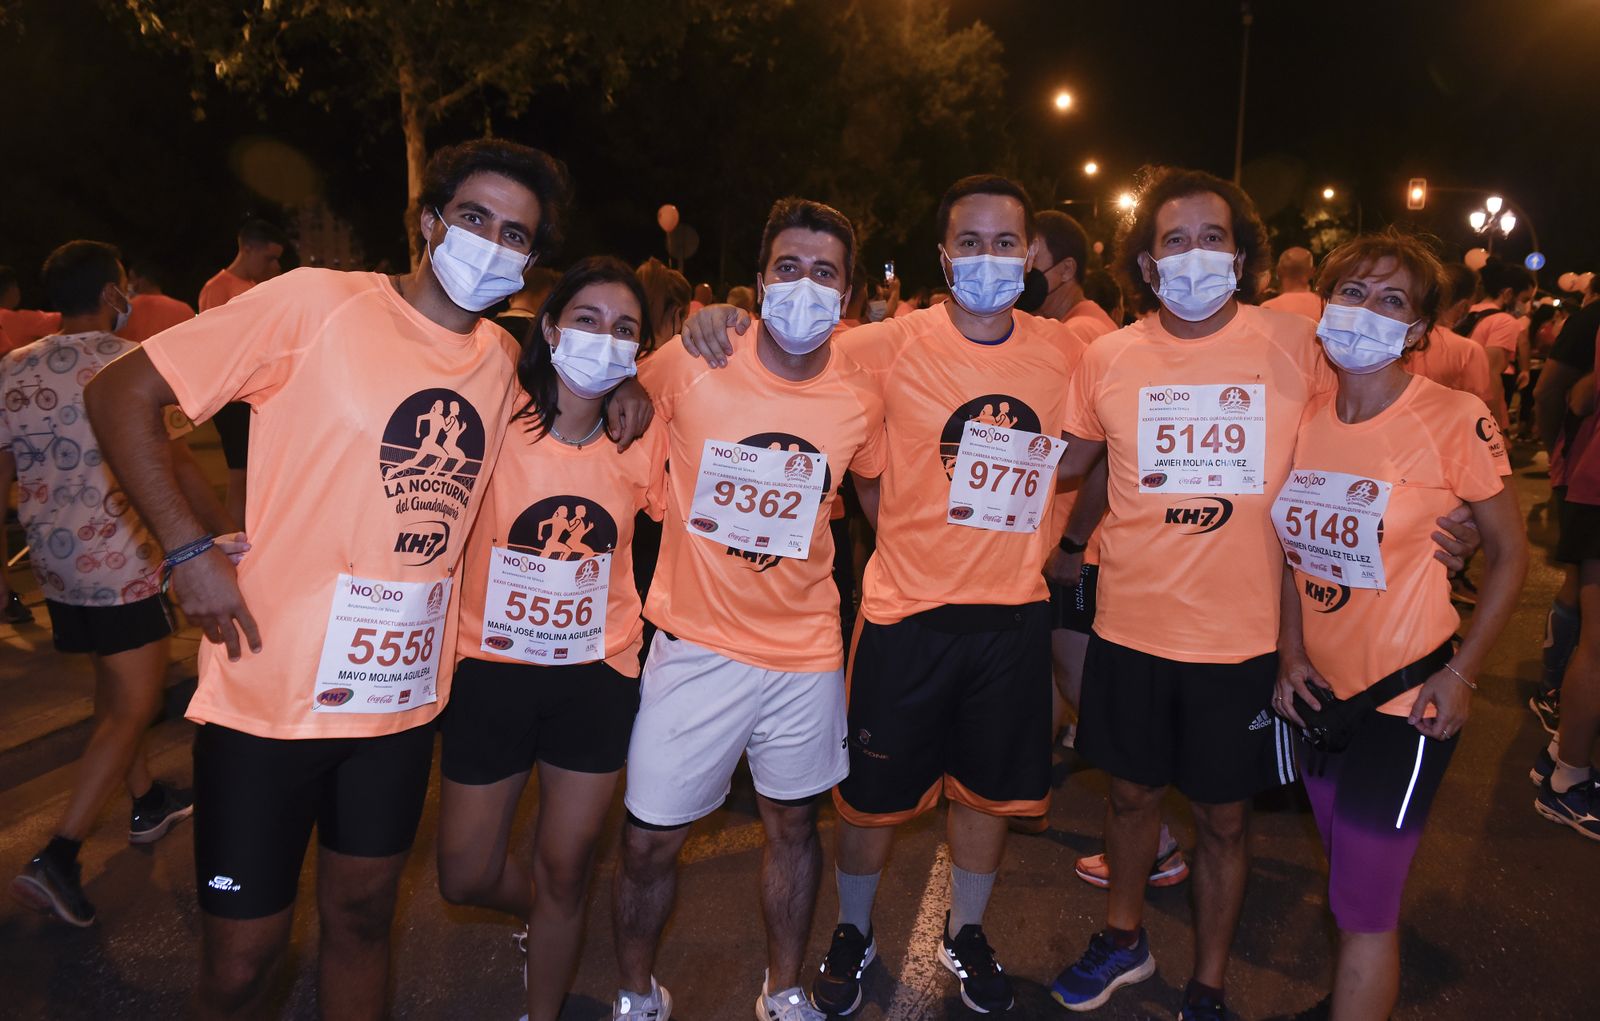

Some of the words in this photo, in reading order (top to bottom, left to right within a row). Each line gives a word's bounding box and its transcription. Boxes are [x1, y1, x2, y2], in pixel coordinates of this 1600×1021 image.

[1156, 424, 1245, 454] 5149
[1154, 459, 1180, 467] JAVIER
[1183, 459, 1213, 467] MOLINA
[1215, 459, 1247, 467] CHAVEZ
[384, 482, 405, 499] LA
[409, 479, 470, 509] NOCTURNA
[968, 461, 1040, 497] 9776
[396, 498, 409, 514] del
[411, 496, 459, 520] Guadalquivir
[713, 480, 802, 520] 9362
[1286, 505, 1359, 548] 5148
[1308, 545, 1342, 559] GONZALEZ
[1342, 552, 1371, 563] TELLEZ
[505, 590, 593, 629] 5556
[487, 620, 512, 633] MARÍA
[514, 626, 534, 638] JOSÉ
[536, 631, 567, 641] MOLINA
[568, 627, 602, 640] AGUILERA
[348, 626, 435, 667] 5558
[338, 670, 367, 681] MAVO
[369, 673, 402, 683] MOLINA
[403, 667, 430, 680] AGUILERA
